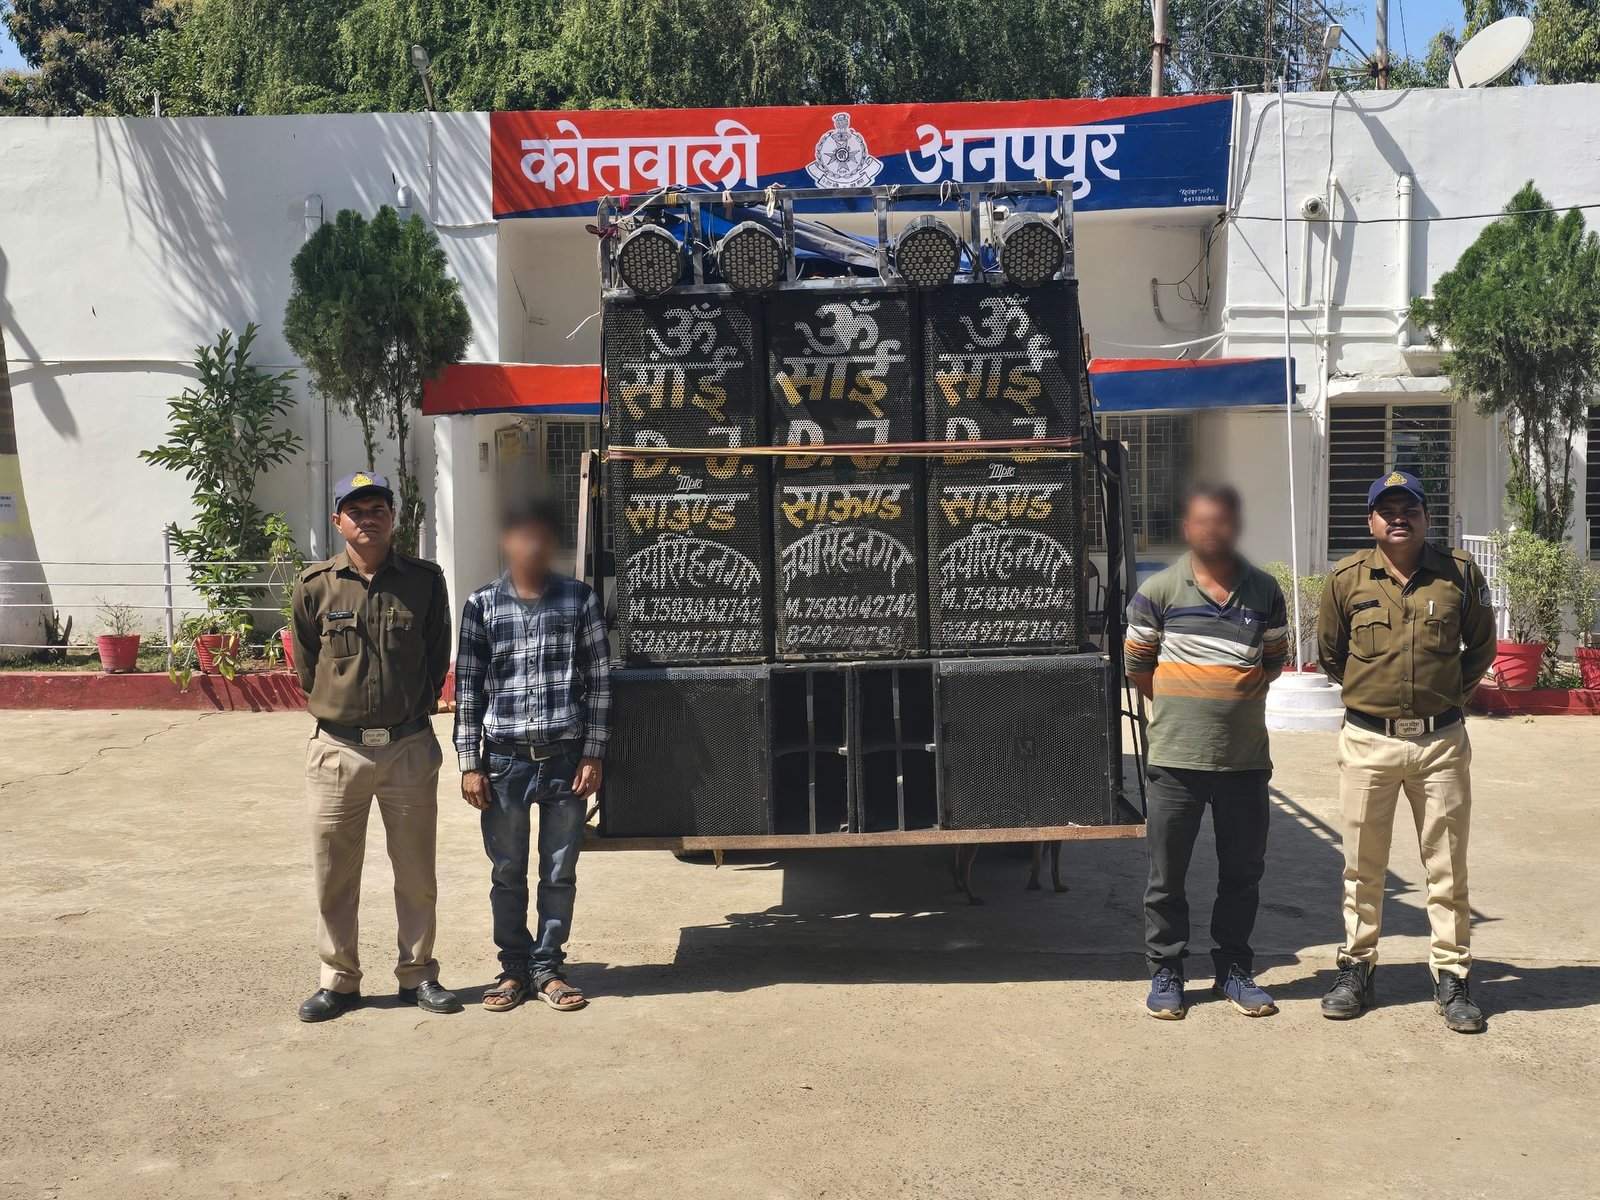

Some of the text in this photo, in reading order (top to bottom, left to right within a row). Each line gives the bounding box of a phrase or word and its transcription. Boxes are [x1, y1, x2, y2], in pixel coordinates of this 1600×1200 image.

[520, 119, 1125, 200] कोतवाली अनपपुर
[619, 346, 744, 422] साई
[775, 339, 906, 418] साई
[934, 334, 1058, 415] साई
